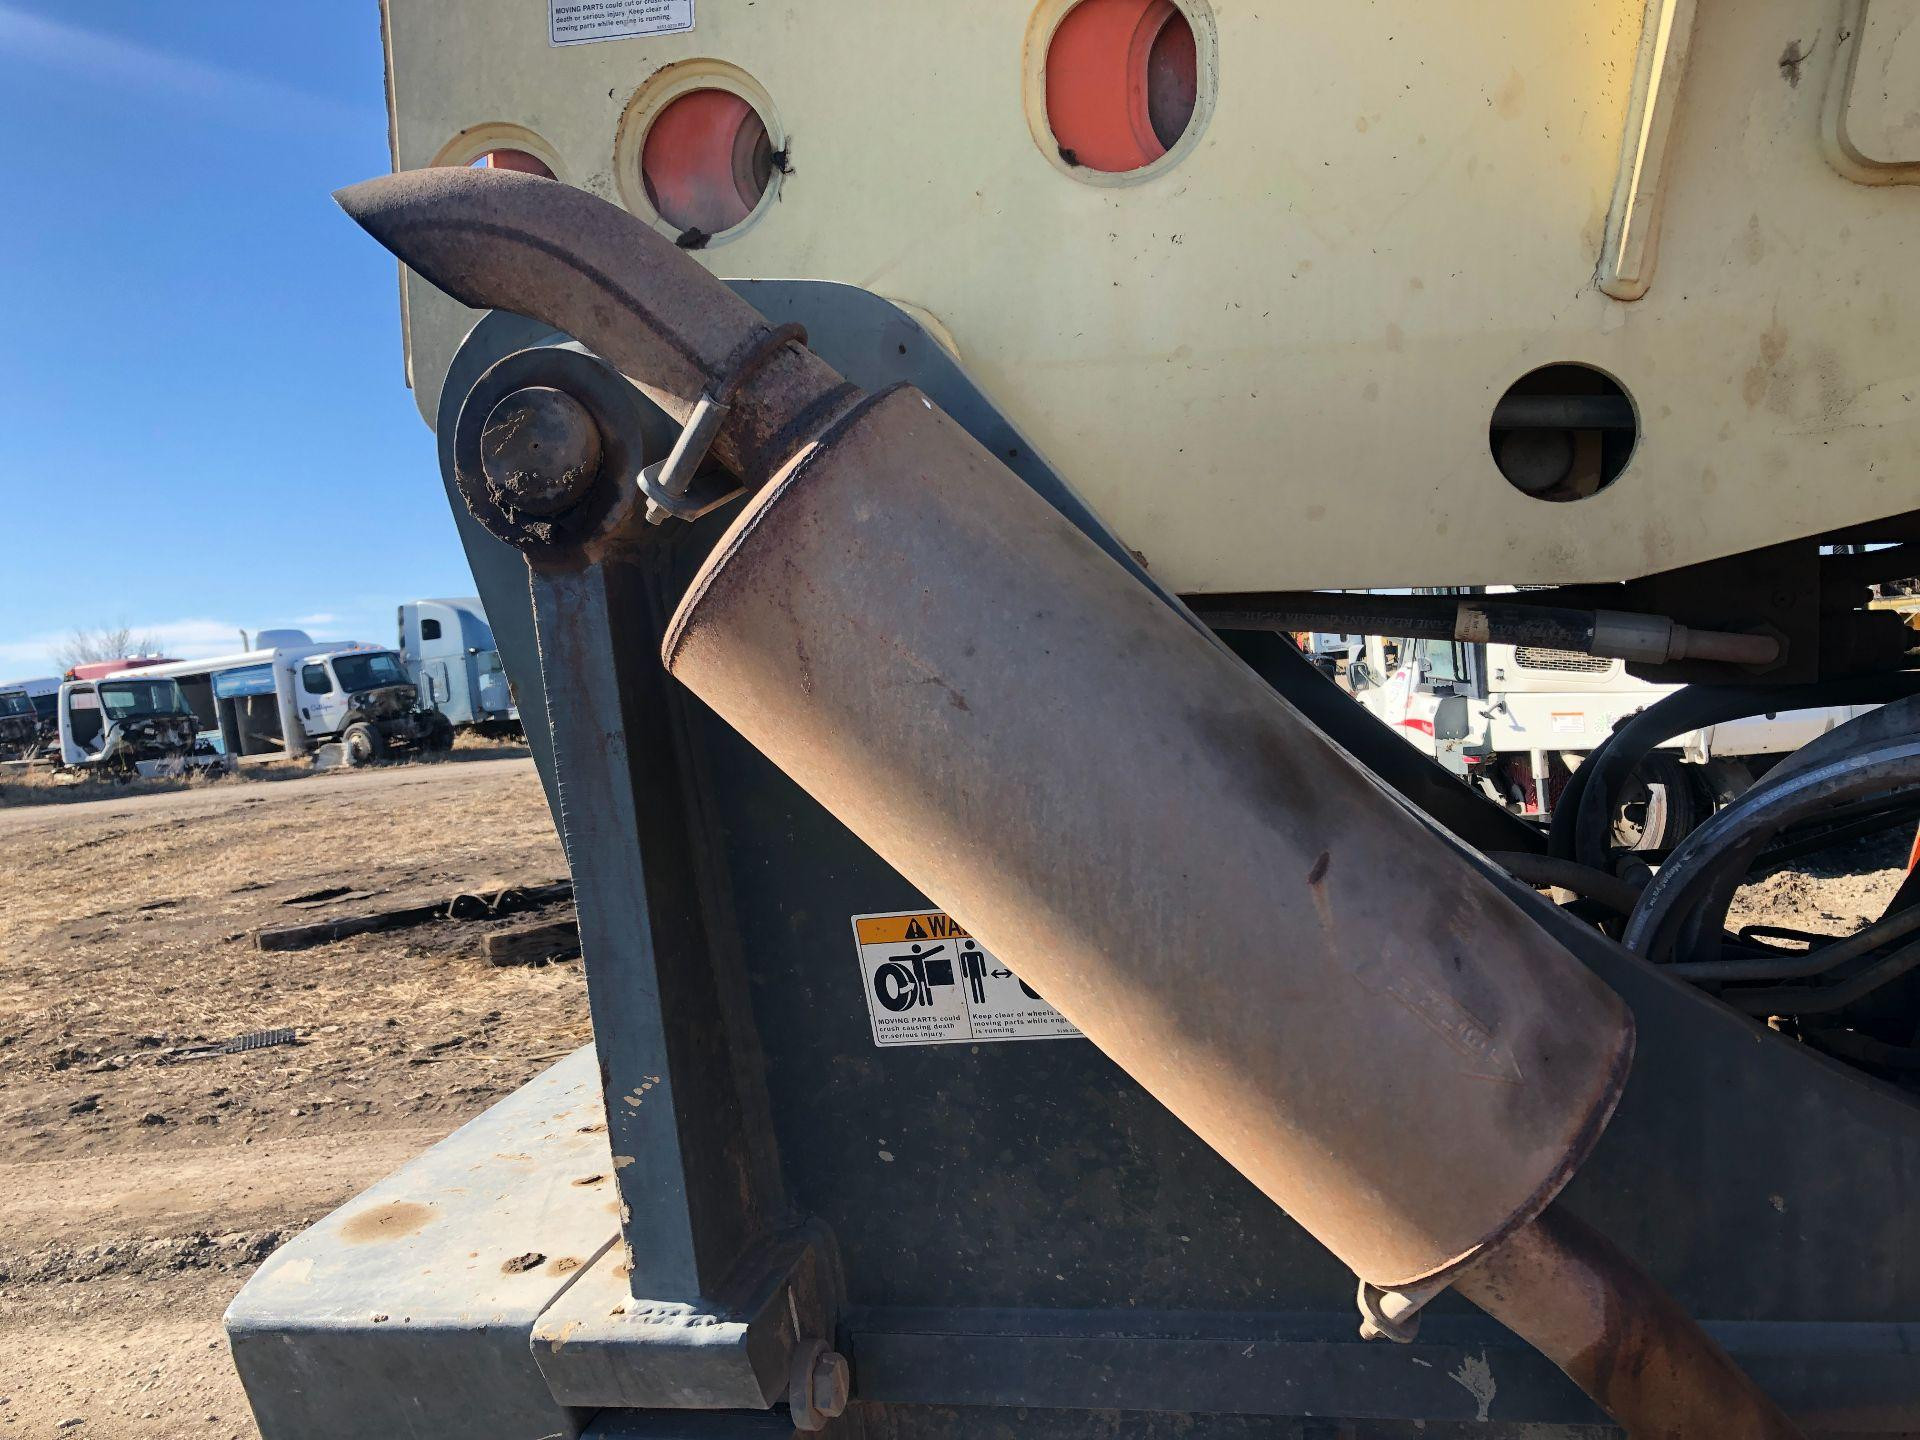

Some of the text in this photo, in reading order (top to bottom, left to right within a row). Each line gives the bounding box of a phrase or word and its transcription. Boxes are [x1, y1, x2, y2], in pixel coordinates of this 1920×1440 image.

[556, 5, 581, 14] MOVING
[583, 3, 603, 11] PARTS
[580, 22, 595, 30] parts
[616, 18, 637, 26] engine
[927, 916, 968, 937] WA
[878, 1017, 909, 1025] MOVING
[902, 1023, 931, 1031] causing
